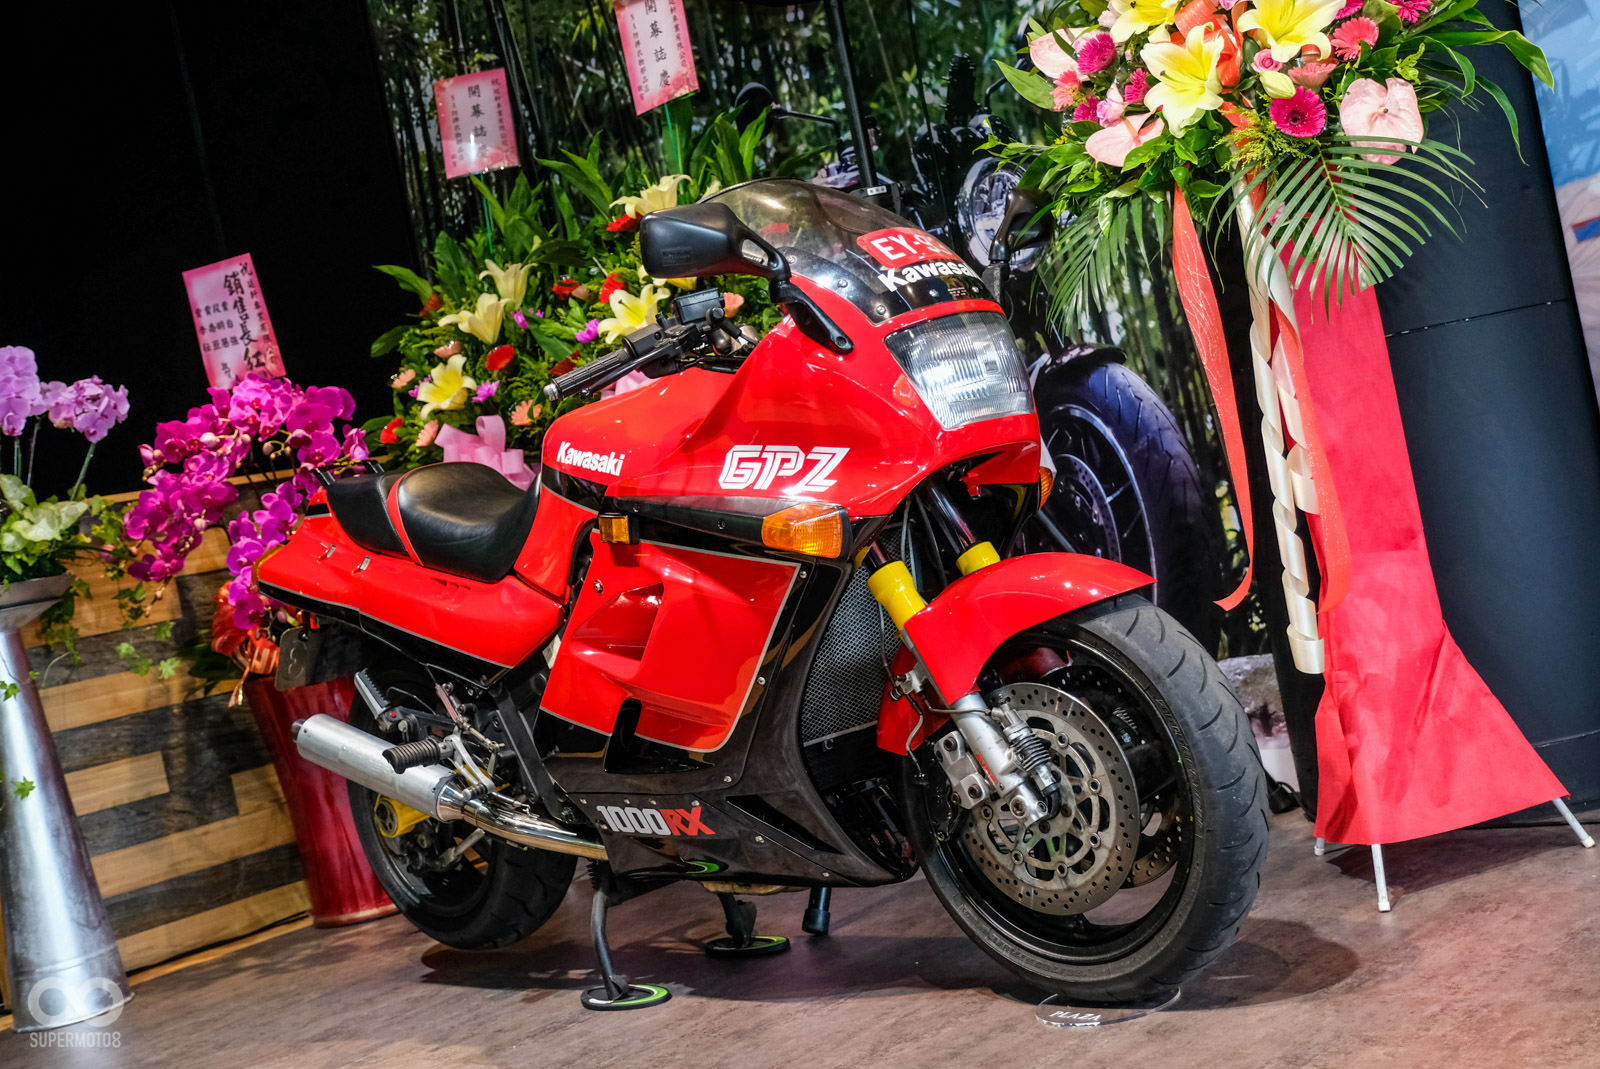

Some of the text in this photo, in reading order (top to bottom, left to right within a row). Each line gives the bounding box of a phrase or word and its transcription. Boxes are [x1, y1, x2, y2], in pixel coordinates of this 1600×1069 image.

[223, 271, 266, 371] 銷售長紅
[556, 441, 625, 476] Kawasaki
[718, 445, 850, 495] GPZ
[596, 805, 716, 836] 1000RX
[1049, 1010, 1102, 1021] PLAZA
